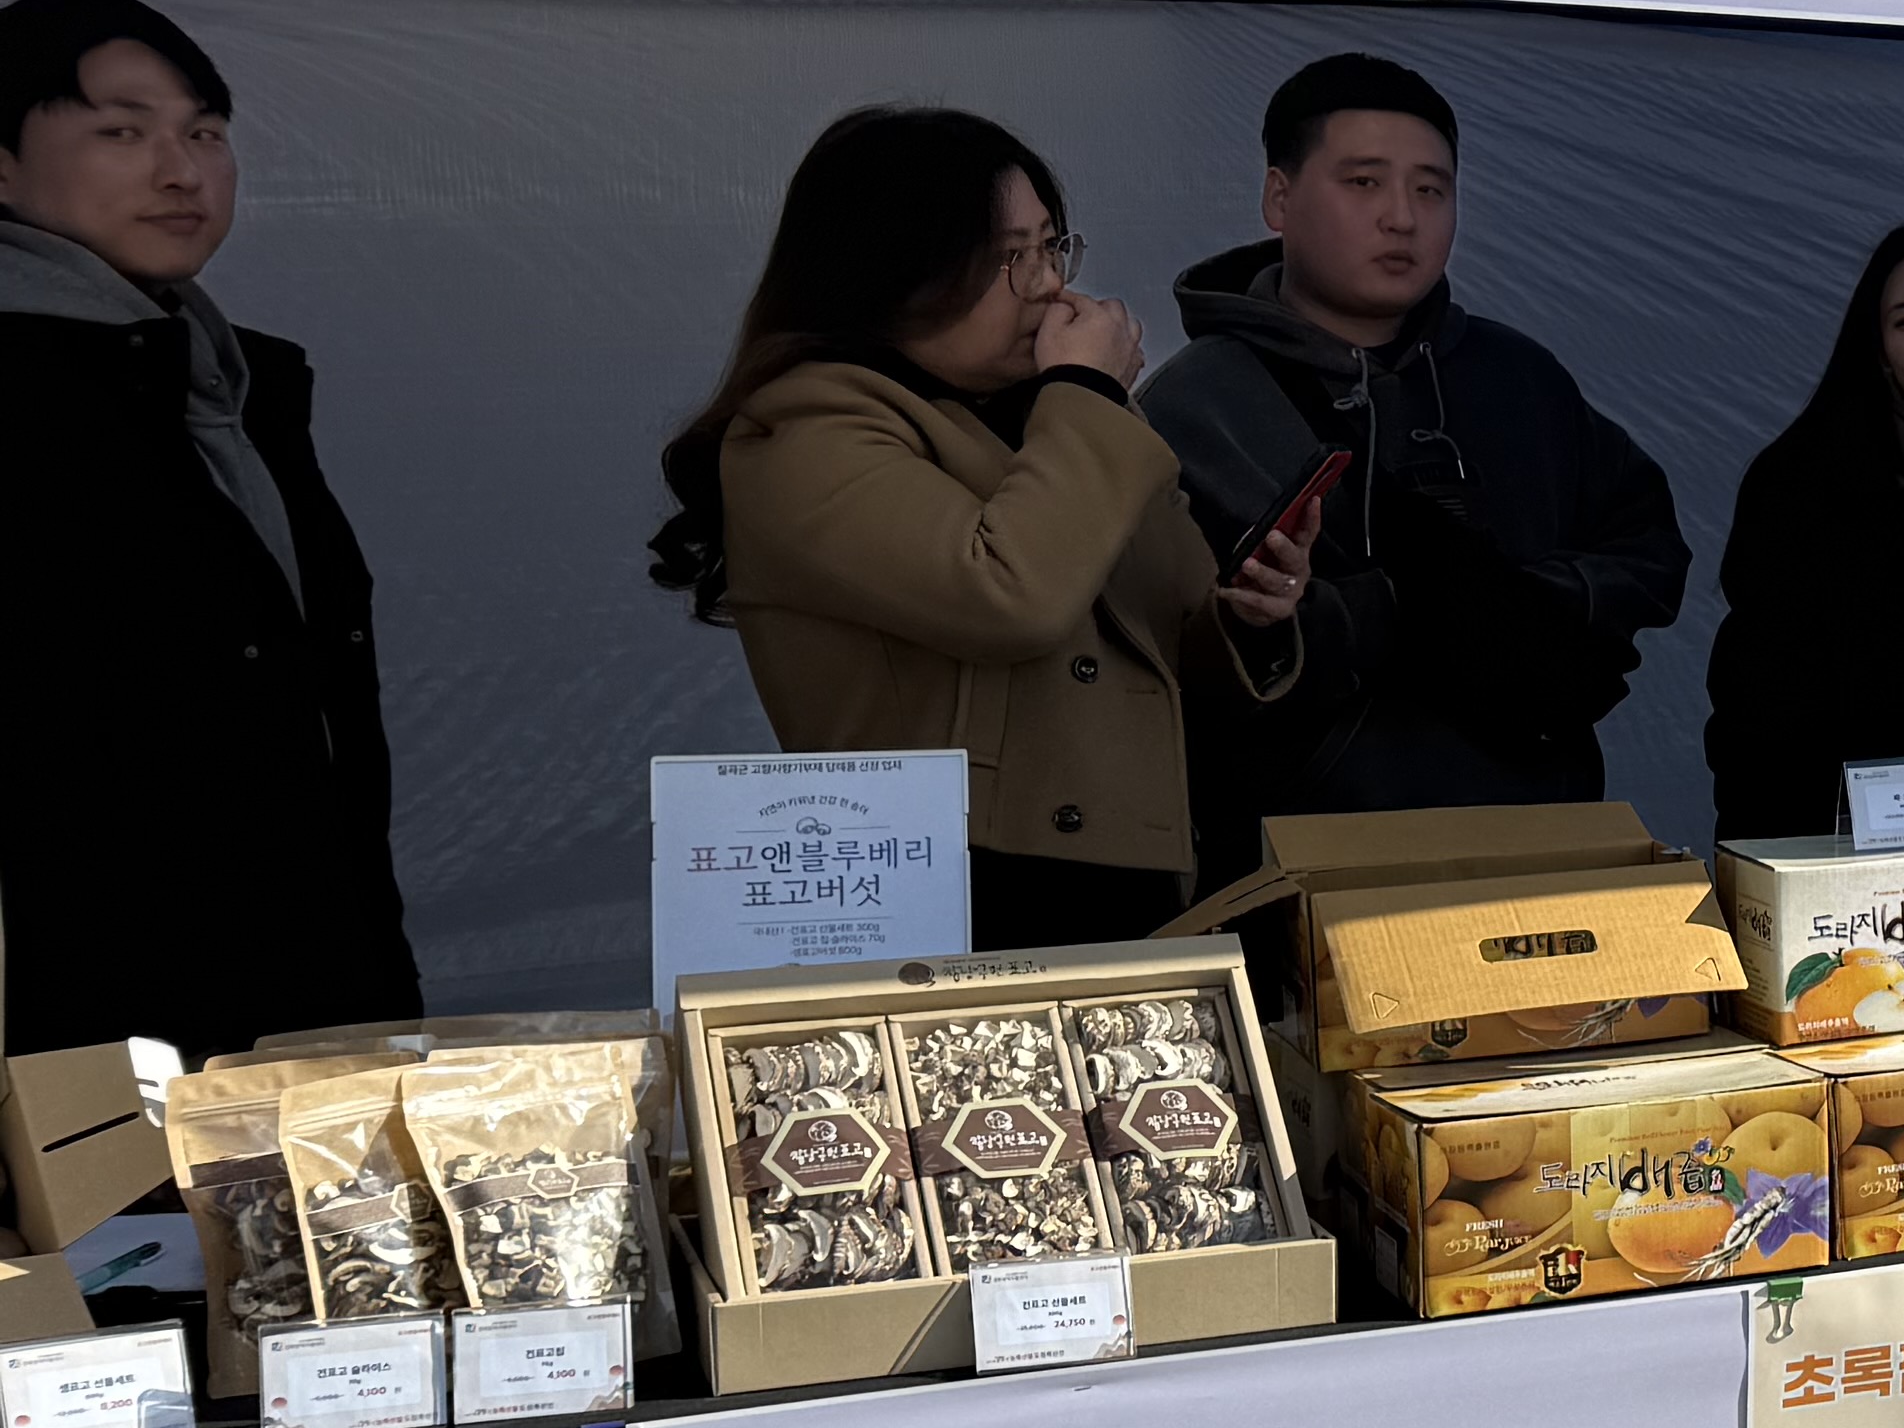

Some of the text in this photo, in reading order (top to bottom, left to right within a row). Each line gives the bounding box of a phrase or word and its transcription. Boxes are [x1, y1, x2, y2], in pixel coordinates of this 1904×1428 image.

[686, 836, 933, 874] 표고앤블루베리
[741, 873, 883, 908] 표고버섯
[1533, 1146, 1708, 1199] 도라지배즙
